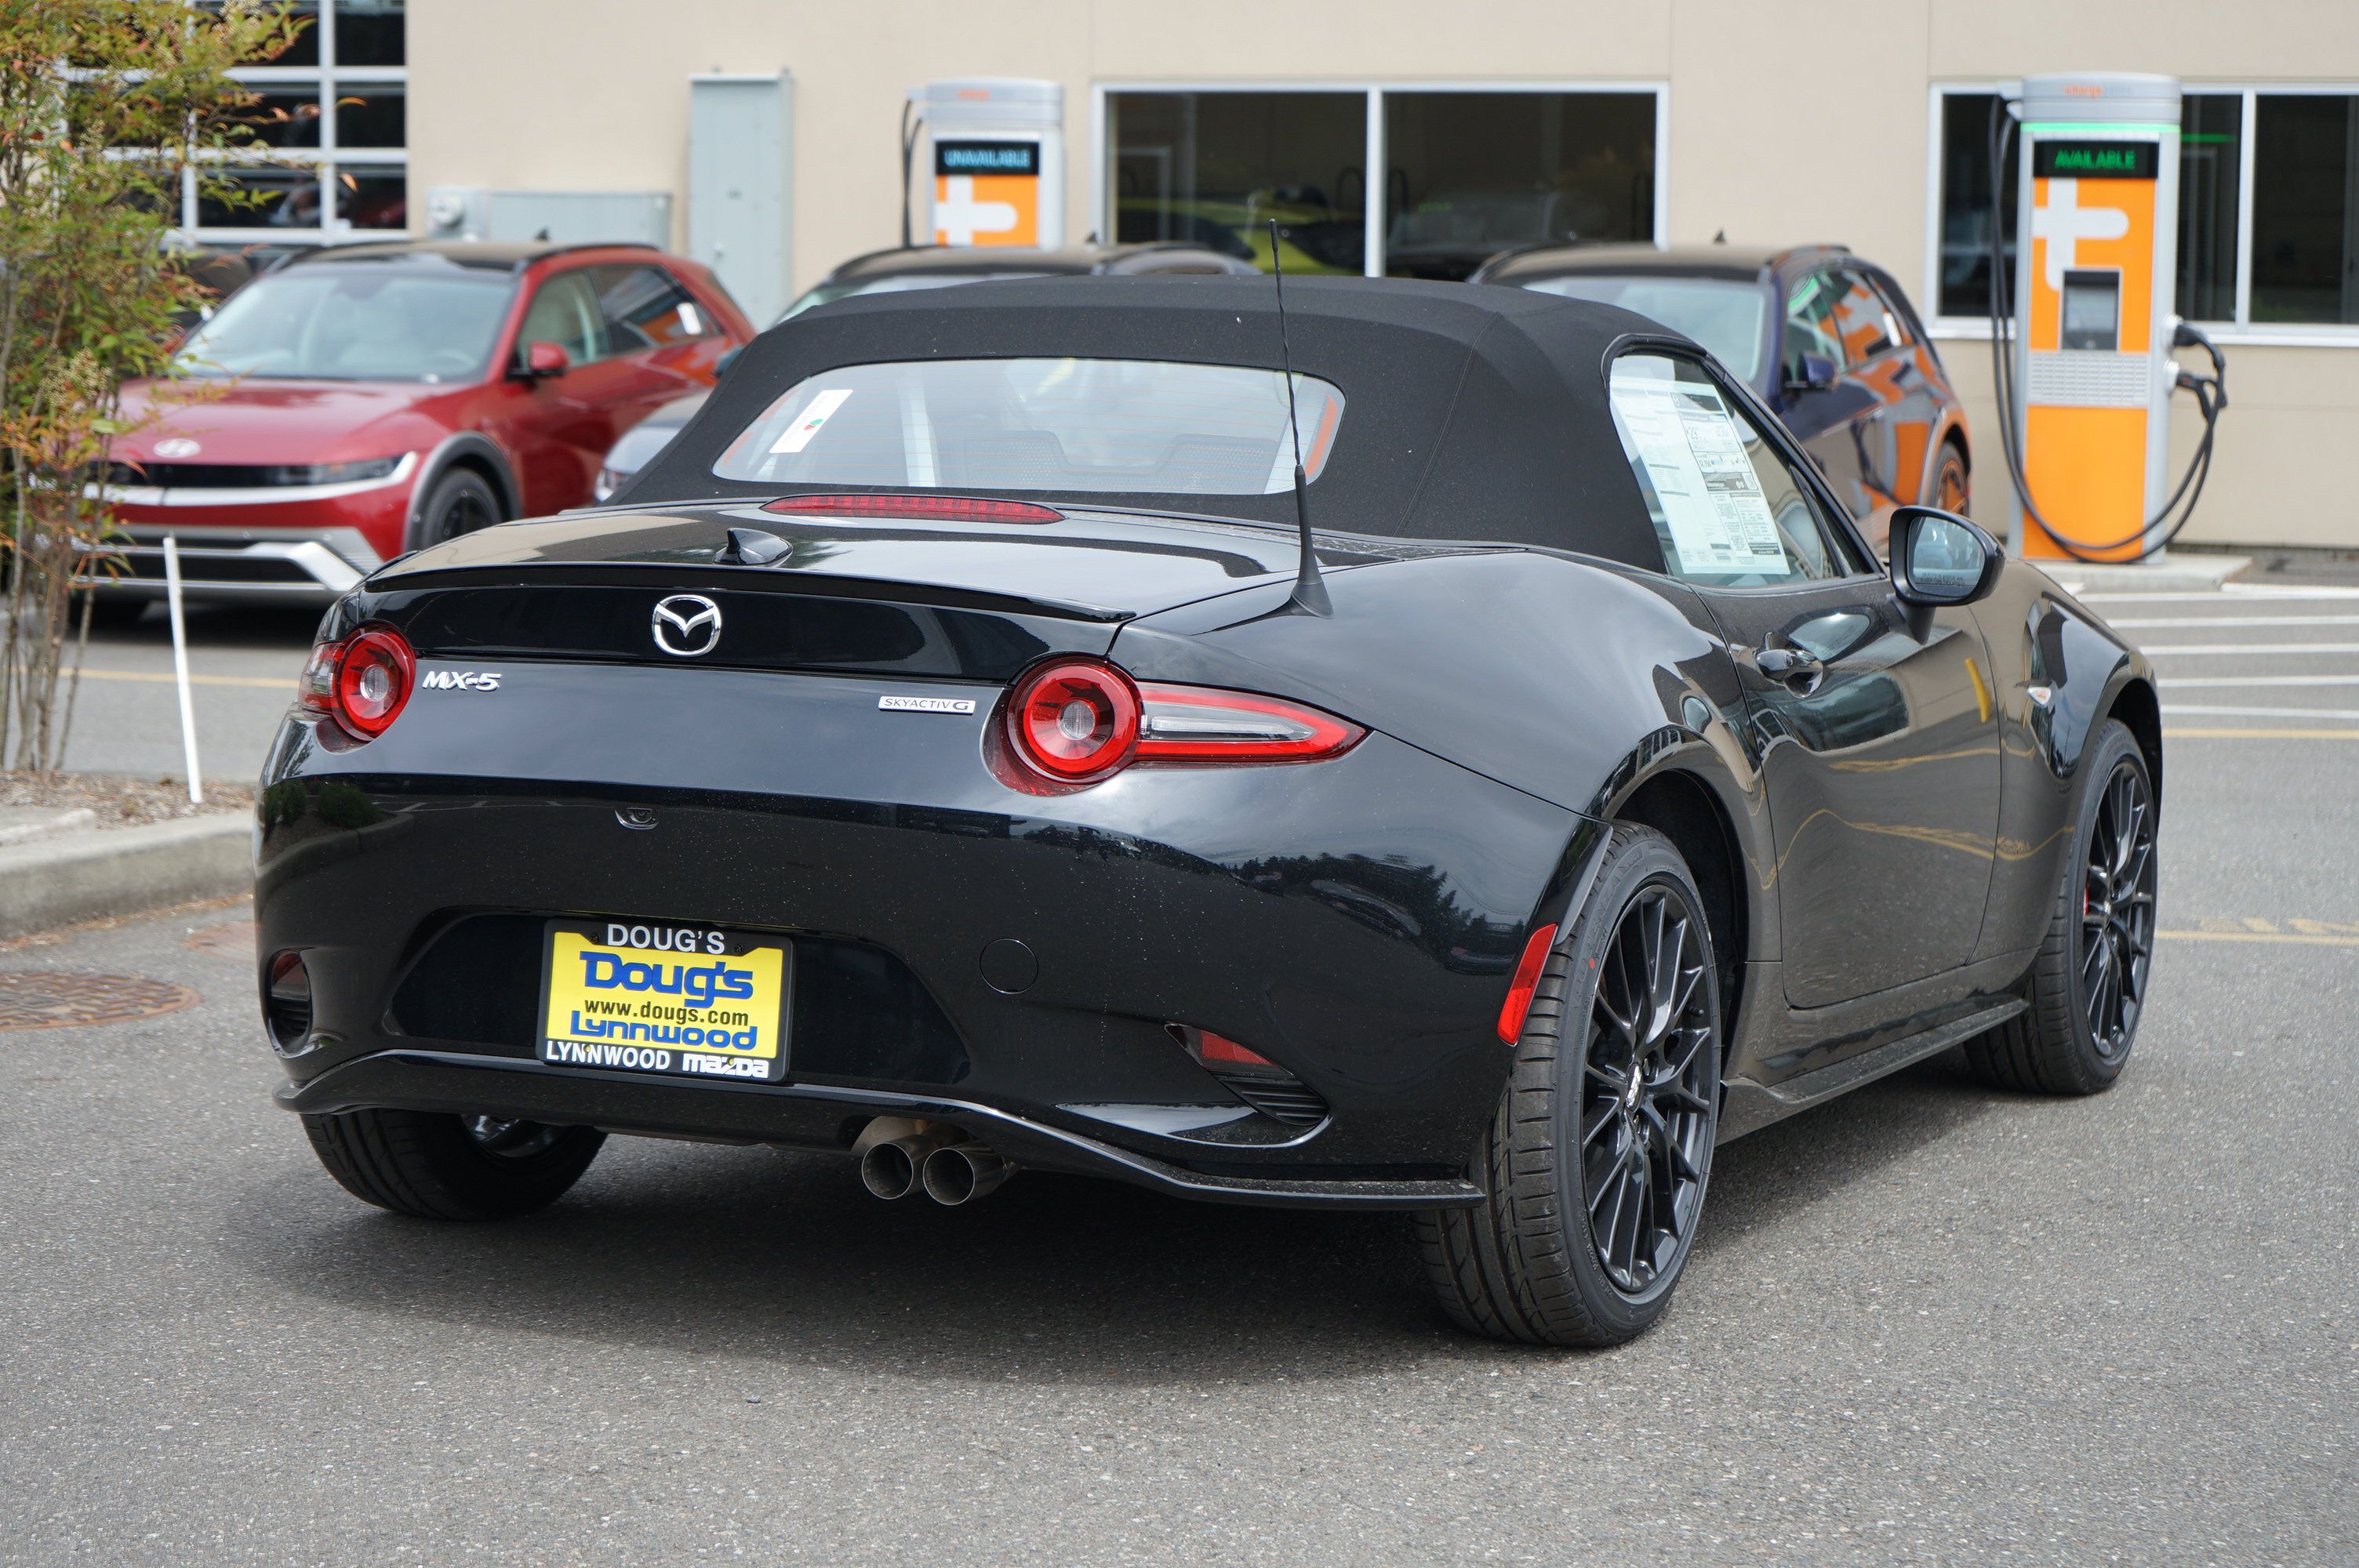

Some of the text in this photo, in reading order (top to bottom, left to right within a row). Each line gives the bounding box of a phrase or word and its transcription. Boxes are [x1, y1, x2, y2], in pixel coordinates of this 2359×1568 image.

[944, 149, 1030, 167] UNAVAILABLE
[2055, 150, 2136, 169] AVAILABLE
[422, 670, 502, 692] MX-5
[607, 924, 725, 955] DOUG'S
[580, 950, 754, 1009] Doug's
[584, 1000, 749, 1026] www.dougs.com
[570, 1010, 758, 1051] Lynnwood
[546, 1040, 671, 1070] LYNNWOOD
